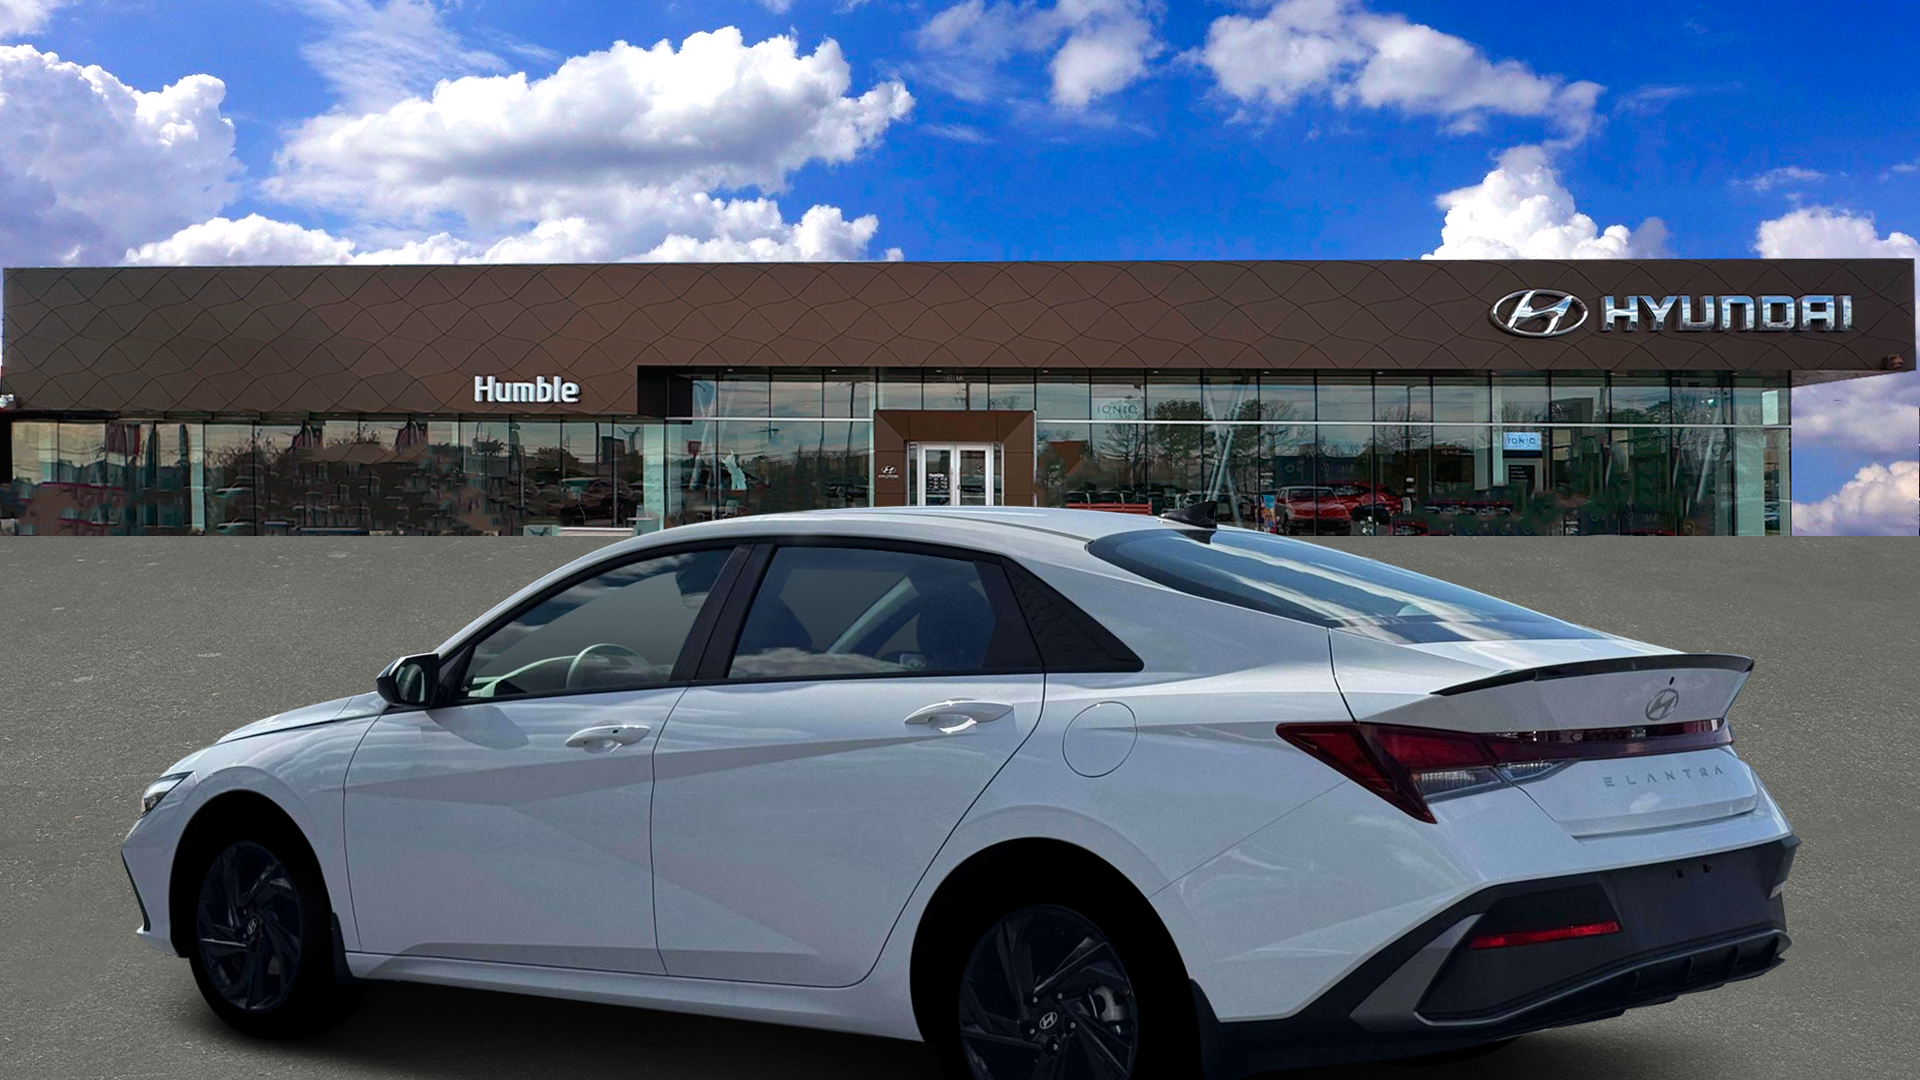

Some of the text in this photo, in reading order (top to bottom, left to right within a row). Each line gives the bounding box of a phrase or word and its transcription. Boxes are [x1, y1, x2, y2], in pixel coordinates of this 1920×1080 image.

[1603, 295, 1852, 331] HYUNDAI
[474, 375, 580, 402] Humble
[1603, 765, 1724, 787] ELANTRA
